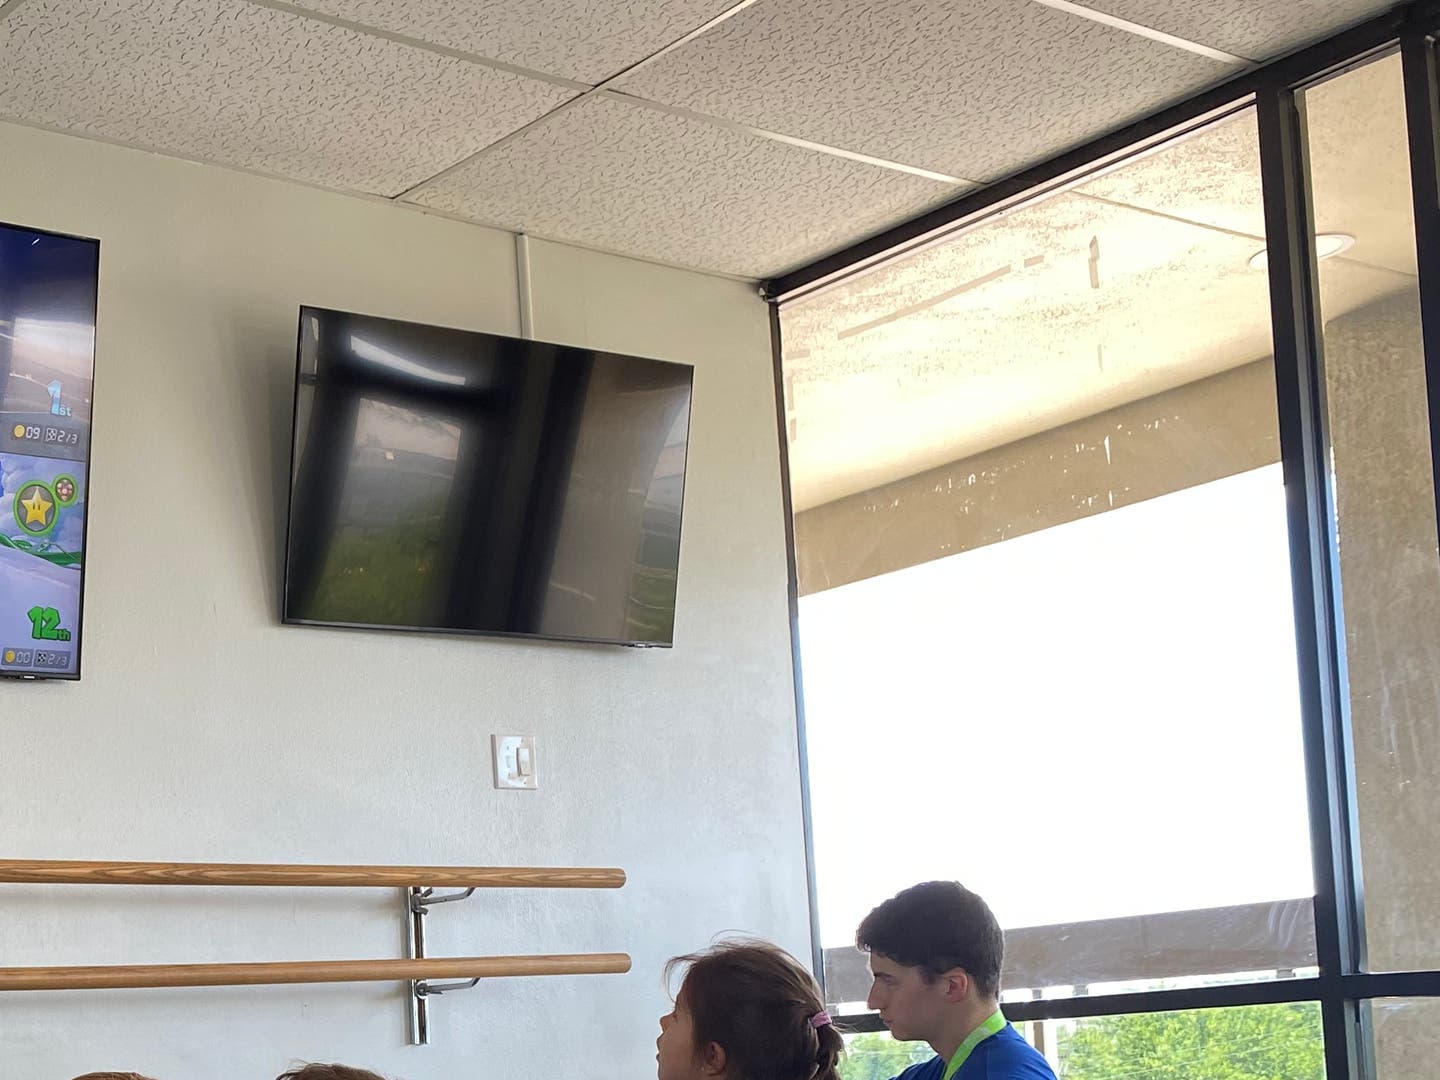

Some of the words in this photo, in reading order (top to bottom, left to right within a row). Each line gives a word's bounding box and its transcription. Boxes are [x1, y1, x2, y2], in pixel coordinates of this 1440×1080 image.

[48, 380, 72, 416] 1st
[25, 426, 40, 439] 09
[57, 430, 78, 444] 2/3
[27, 606, 71, 641] 12th
